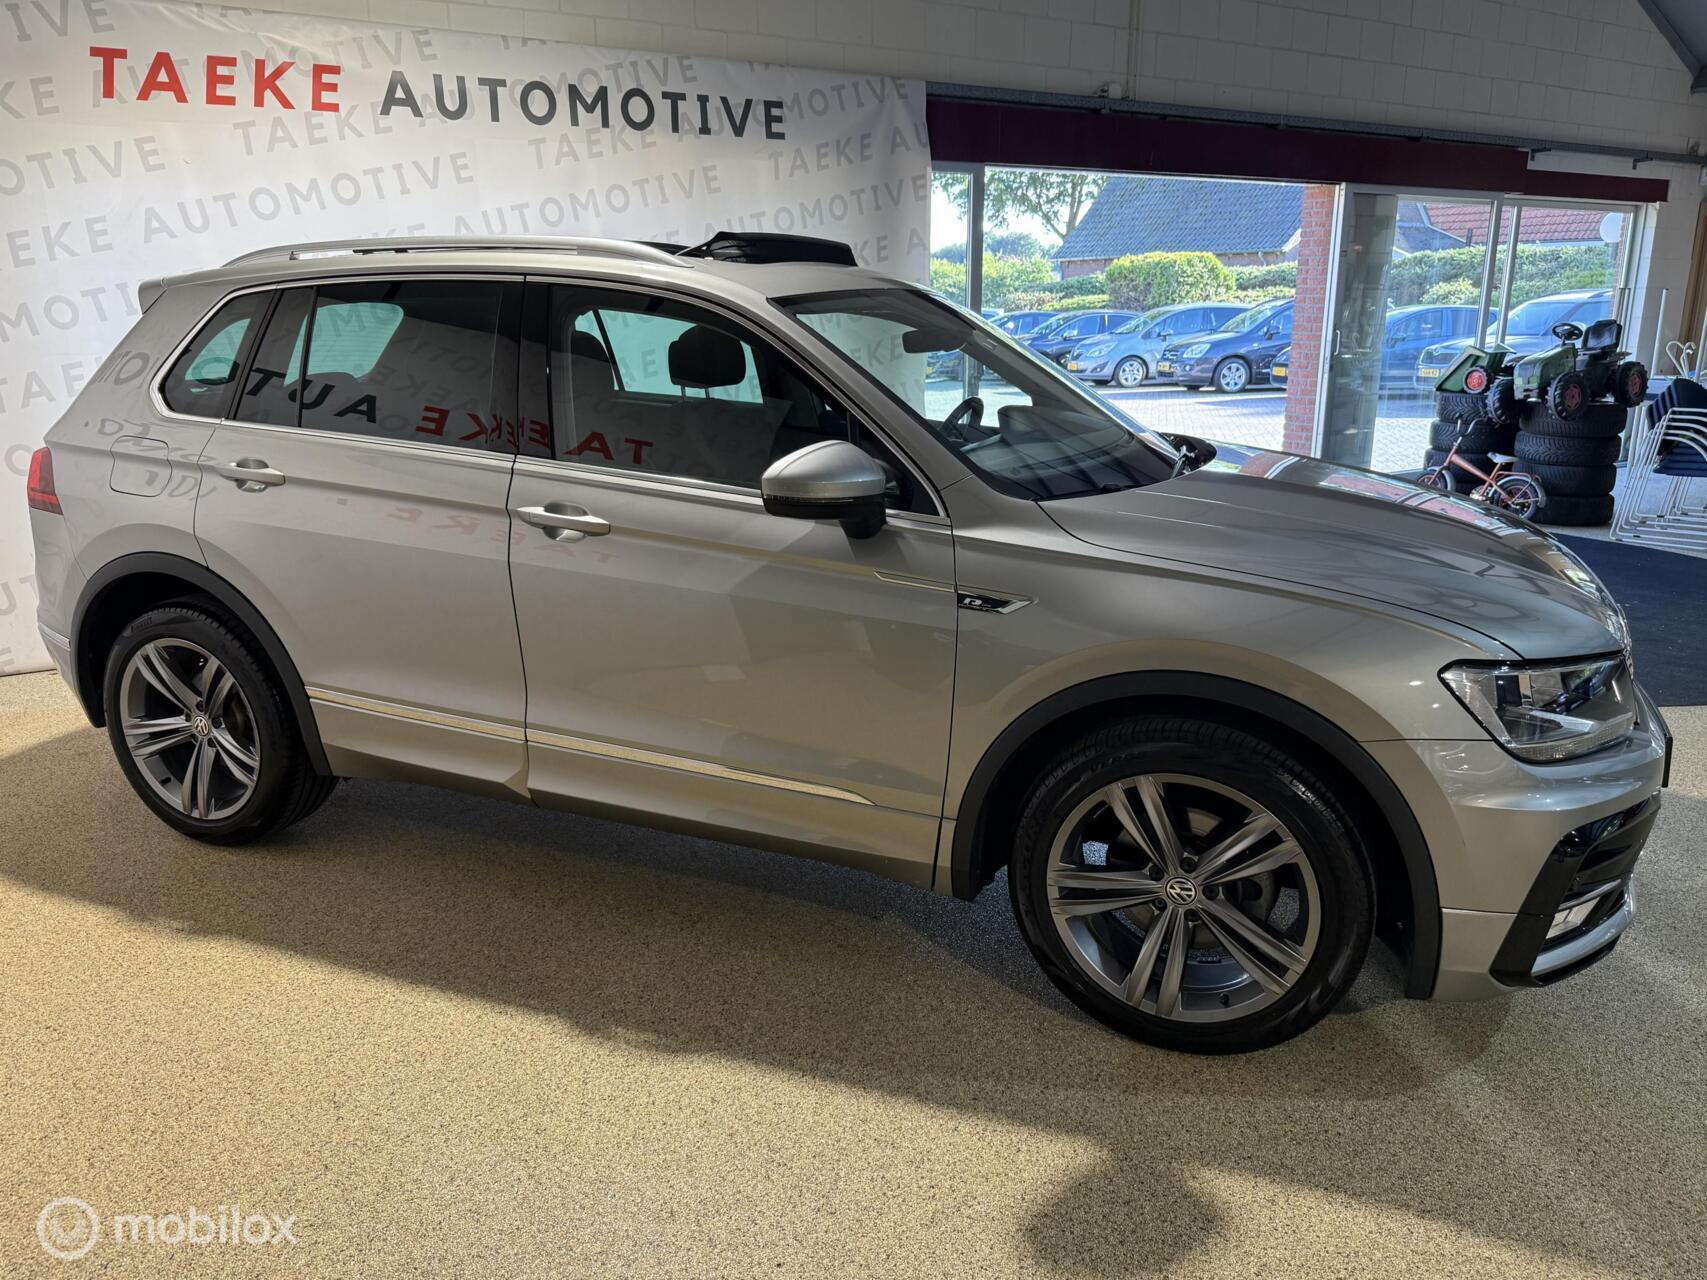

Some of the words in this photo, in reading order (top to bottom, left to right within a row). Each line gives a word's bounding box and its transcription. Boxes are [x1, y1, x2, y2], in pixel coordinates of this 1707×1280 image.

[89, 46, 342, 113] TAEKE
[379, 70, 786, 140] AUTOMOTIVE
[232, 104, 393, 157] TAEKE
[142, 151, 474, 244] AUTOMOTIVE
[527, 127, 657, 170] TAEKE
[454, 164, 722, 237] AUTOMOTIVE
[767, 132, 873, 181] TAEKE
[703, 173, 929, 244] AUTOMOTIVE
